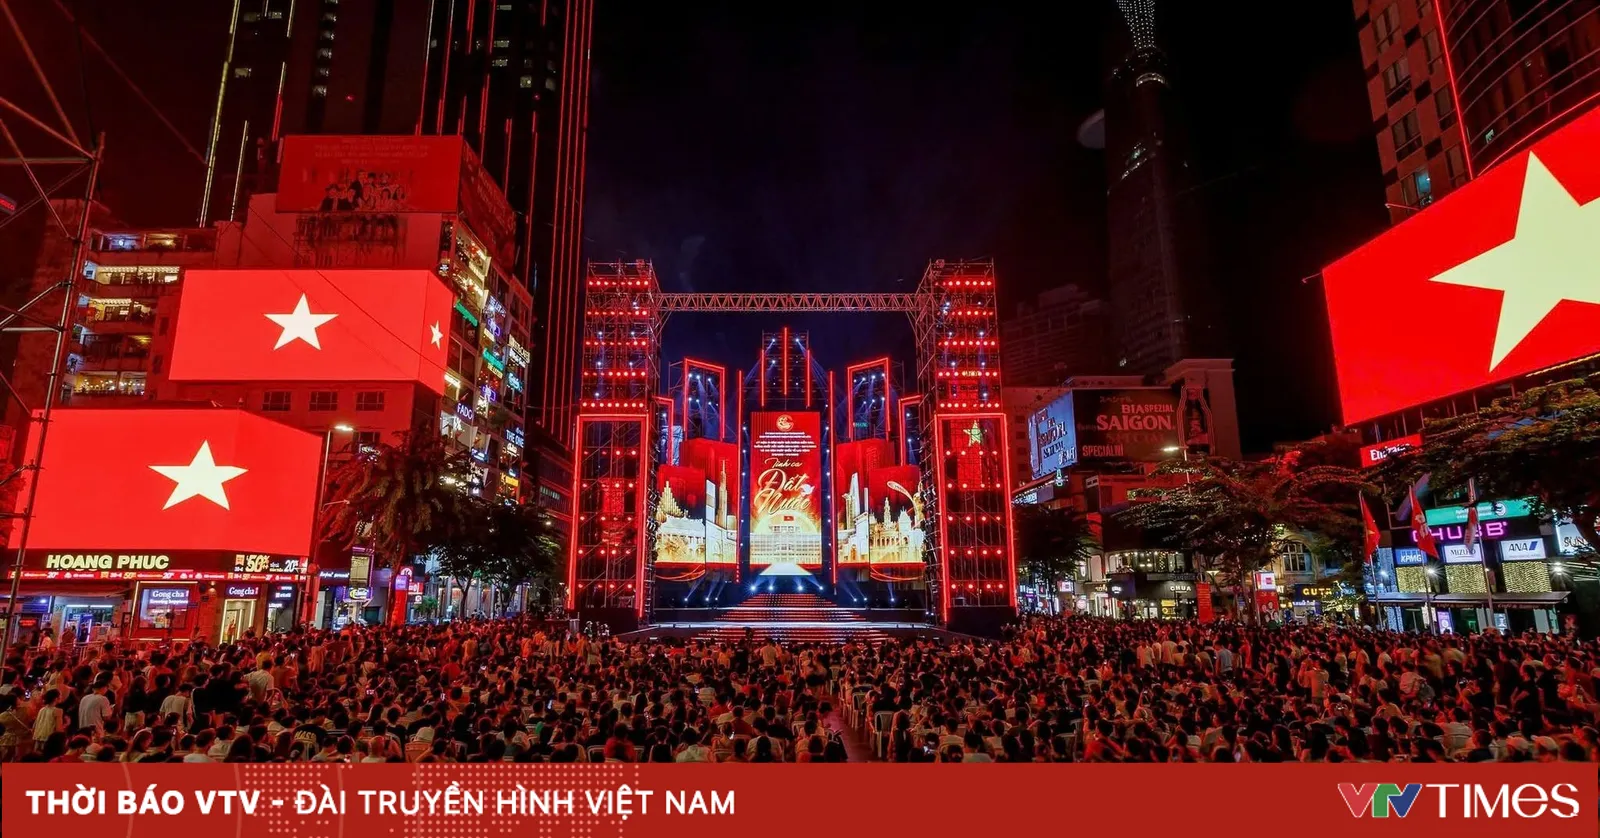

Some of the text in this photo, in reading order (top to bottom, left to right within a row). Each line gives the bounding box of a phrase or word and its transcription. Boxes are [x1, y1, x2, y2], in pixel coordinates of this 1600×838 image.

[1121, 404, 1144, 413] BIA
[1508, 542, 1528, 551] ANA
[46, 554, 169, 569] HOANG PHUC
[1400, 553, 1422, 563] KPMG
